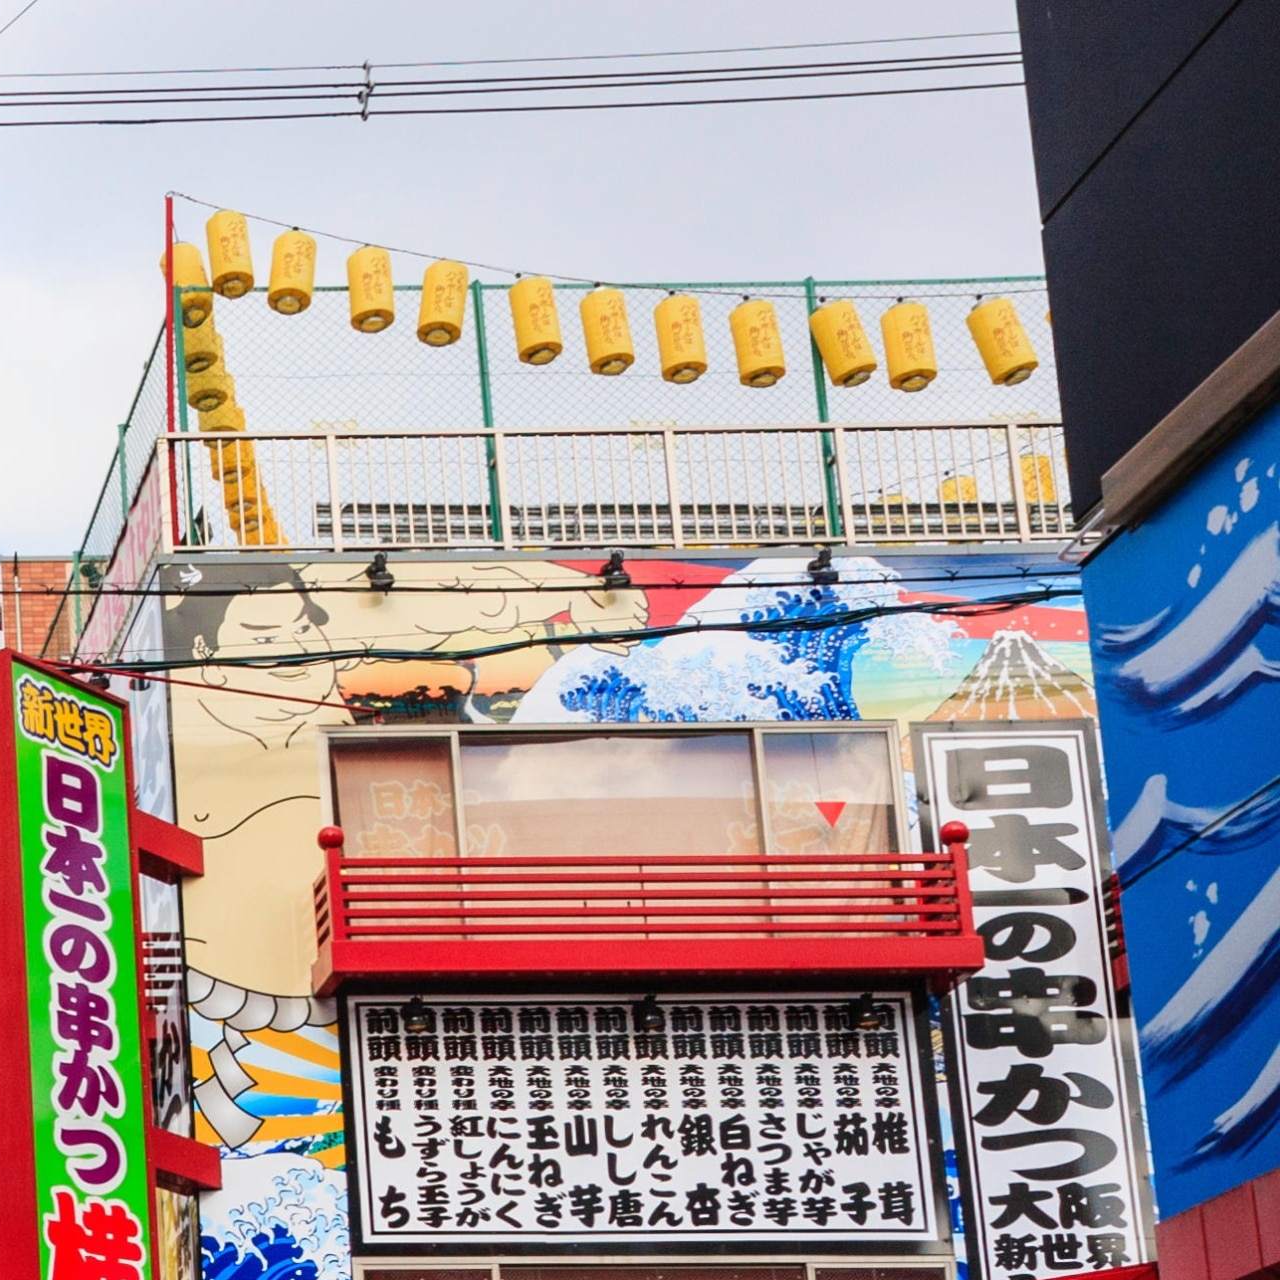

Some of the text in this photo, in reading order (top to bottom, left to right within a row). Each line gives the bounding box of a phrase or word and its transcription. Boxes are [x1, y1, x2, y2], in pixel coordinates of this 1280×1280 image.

[19, 680, 117, 767] 新世界
[44, 755, 122, 1184] 日本一の串かつ
[945, 745, 1118, 1180] 日本一の串かつ
[373, 1115, 411, 1229] もち
[410, 1115, 453, 1229] うずら玉子
[448, 1115, 491, 1228] 紅しょうが
[486, 1115, 525, 1228] にんにく
[525, 1115, 566, 1228] 玉ねぎ
[563, 1114, 605, 1228] 山芋
[602, 1114, 645, 1228] しし唐
[640, 1113, 684, 1228] れんこん
[677, 1113, 721, 1227] 銀杏
[718, 1113, 760, 1227] 白ねぎ
[756, 1112, 800, 1227] さつま芋
[795, 1112, 838, 1227] じゃが芋
[833, 1112, 878, 1226] 茄子
[871, 1112, 915, 1226] 椎茸
[989, 1182, 1129, 1231] 大阪
[994, 1233, 1132, 1272] 新世界
